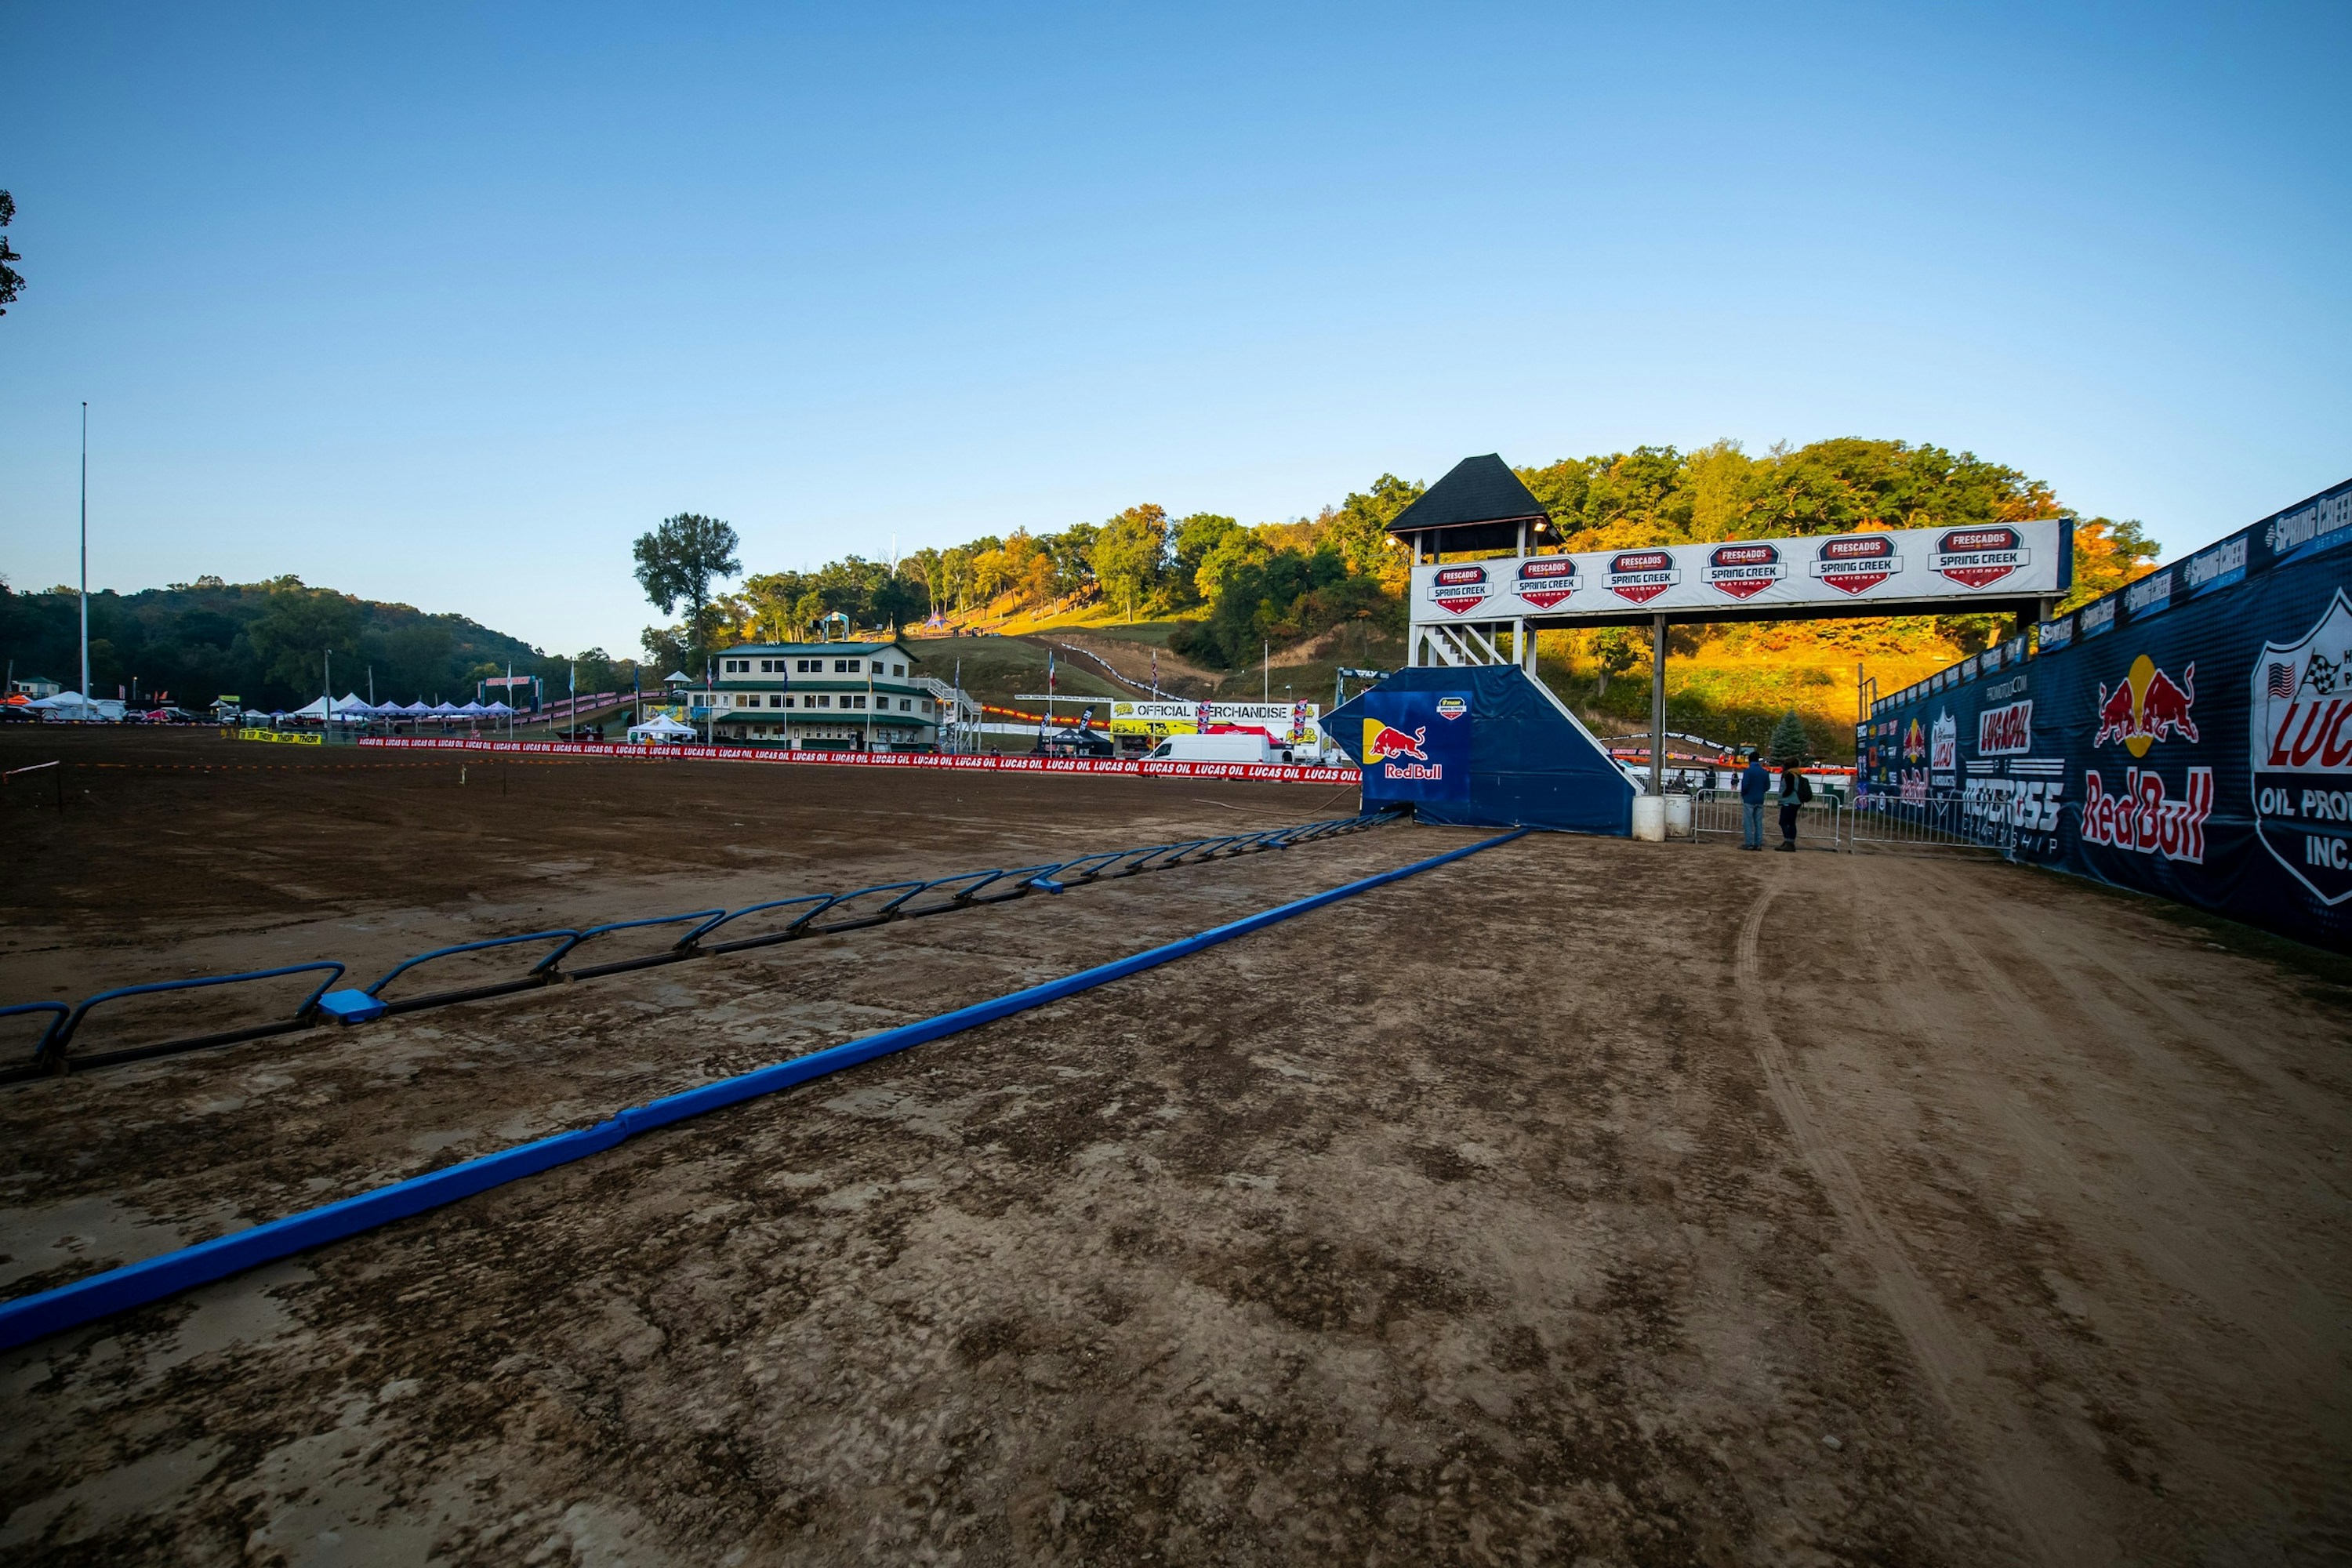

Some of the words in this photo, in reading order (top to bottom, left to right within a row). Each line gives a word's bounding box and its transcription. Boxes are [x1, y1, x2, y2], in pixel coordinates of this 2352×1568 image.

[2275, 506, 2317, 552] SPRING
[1953, 533, 2005, 545] FRESCADOS
[1832, 542, 1881, 553] FRESCADOS
[1722, 550, 1766, 560] FRESCADOS
[1940, 554, 1979, 566] SPRING
[1981, 553, 2017, 564] CREEK
[1621, 556, 1662, 567] FRESCADOS
[1820, 562, 1857, 573] SPRING
[1859, 560, 1892, 571] CREEK
[1528, 563, 1566, 573] FRESCADOS
[1711, 568, 1744, 579] SPRING
[1746, 567, 1777, 576] CREEK
[1443, 571, 1478, 579] FRESCADOS
[1611, 574, 1642, 584] SPRING
[1643, 573, 1671, 583] CREEK
[1519, 580, 1547, 590] SPRING
[1548, 579, 1573, 588] CREEK
[1435, 587, 1461, 597] SPRING
[1461, 586, 1486, 595] CREEK
[1138, 705, 1191, 717] OFFICIAL
[2267, 699, 2352, 768] LUC
[940, 757, 953, 765] OIL
[955, 757, 981, 766] LUCAS
[983, 758, 996, 767] OIL
[1029, 760, 1042, 768] OIL
[1047, 760, 1074, 769] LUCAS
[1076, 761, 1091, 770] OIL
[1094, 762, 1123, 771] LUCAS
[1125, 763, 1139, 771] OIL
[1144, 764, 1174, 772] LUCAS
[1176, 764, 1190, 773] OIL
[1195, 765, 1227, 775] LUCAS
[1229, 766, 1243, 775] OIL
[1248, 768, 1281, 777] LUCAS
[1283, 768, 1299, 778] OIL
[1304, 770, 1338, 779] LUCAS
[1340, 771, 1357, 780] OIL
[1385, 763, 1414, 779] Red
[1414, 764, 1442, 779] Bull
[2260, 787, 2296, 815] OIL
[2082, 766, 2140, 850] Red
[2136, 766, 2213, 865] Bull
